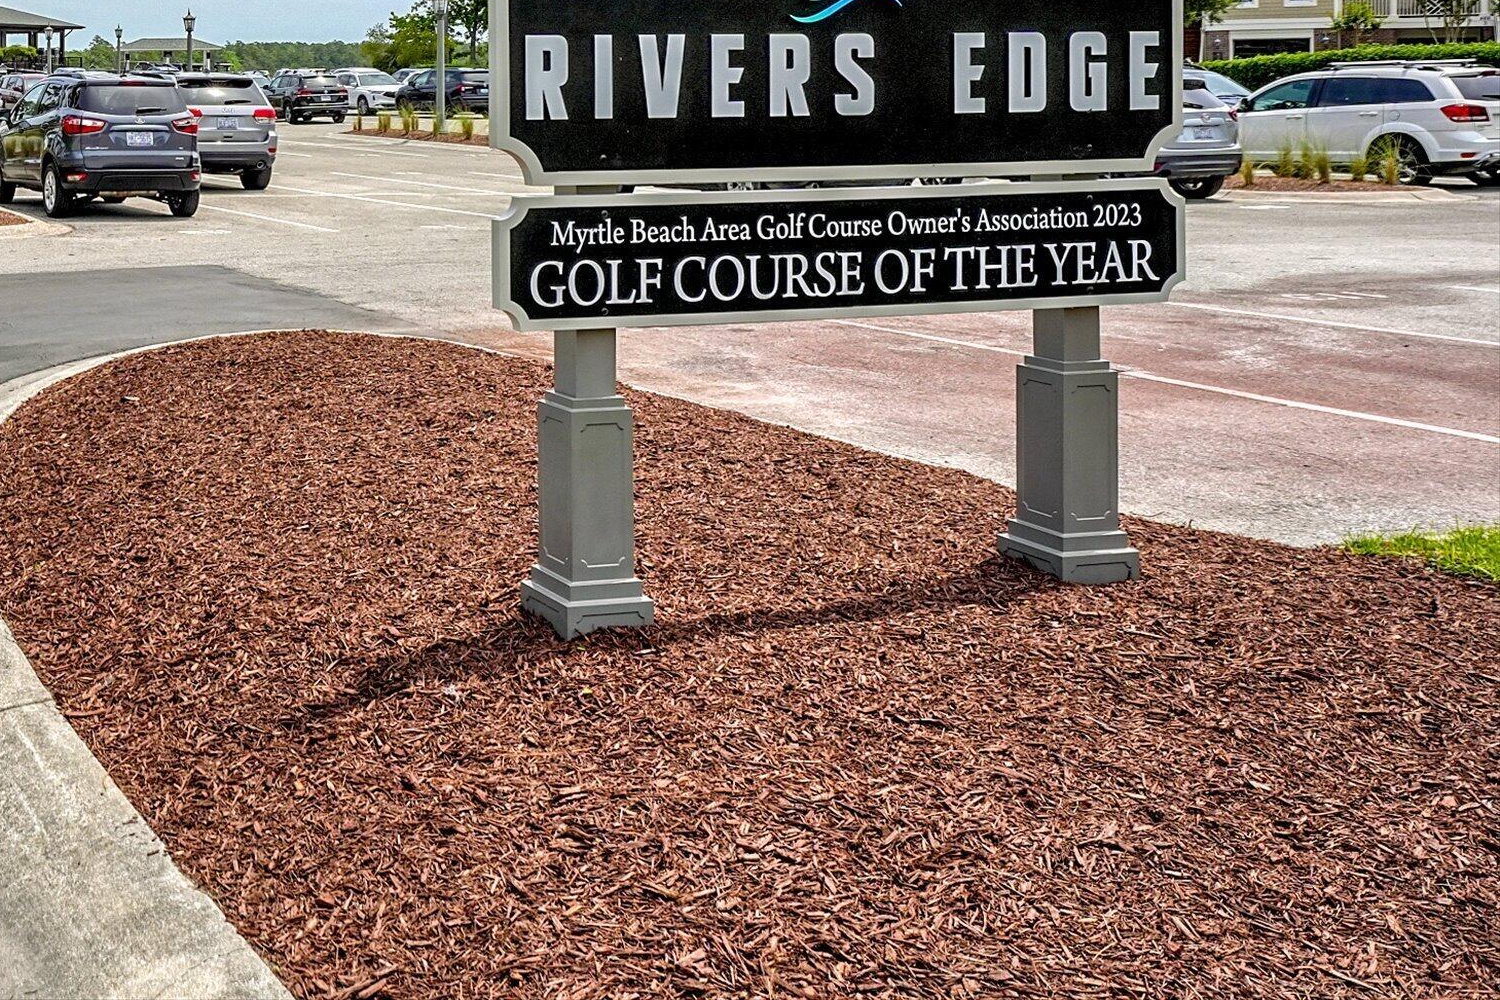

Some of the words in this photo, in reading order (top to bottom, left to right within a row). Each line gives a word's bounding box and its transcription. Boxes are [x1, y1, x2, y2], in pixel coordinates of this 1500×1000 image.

[524, 32, 876, 121] RIVERS
[953, 30, 1160, 114] EDGE
[550, 219, 625, 253] Myrtle
[629, 216, 697, 244] Beach
[699, 216, 751, 242] Area
[756, 212, 805, 240] Golf
[808, 213, 883, 239] Course
[887, 207, 971, 236] Owner's
[974, 204, 1089, 233] Association
[1092, 203, 1142, 228] 2023
[529, 258, 663, 308] GOLF
[673, 250, 866, 302] COURSE
[873, 247, 937, 295] OF
[942, 243, 1039, 292] THE
[1042, 238, 1161, 286] YEAR
